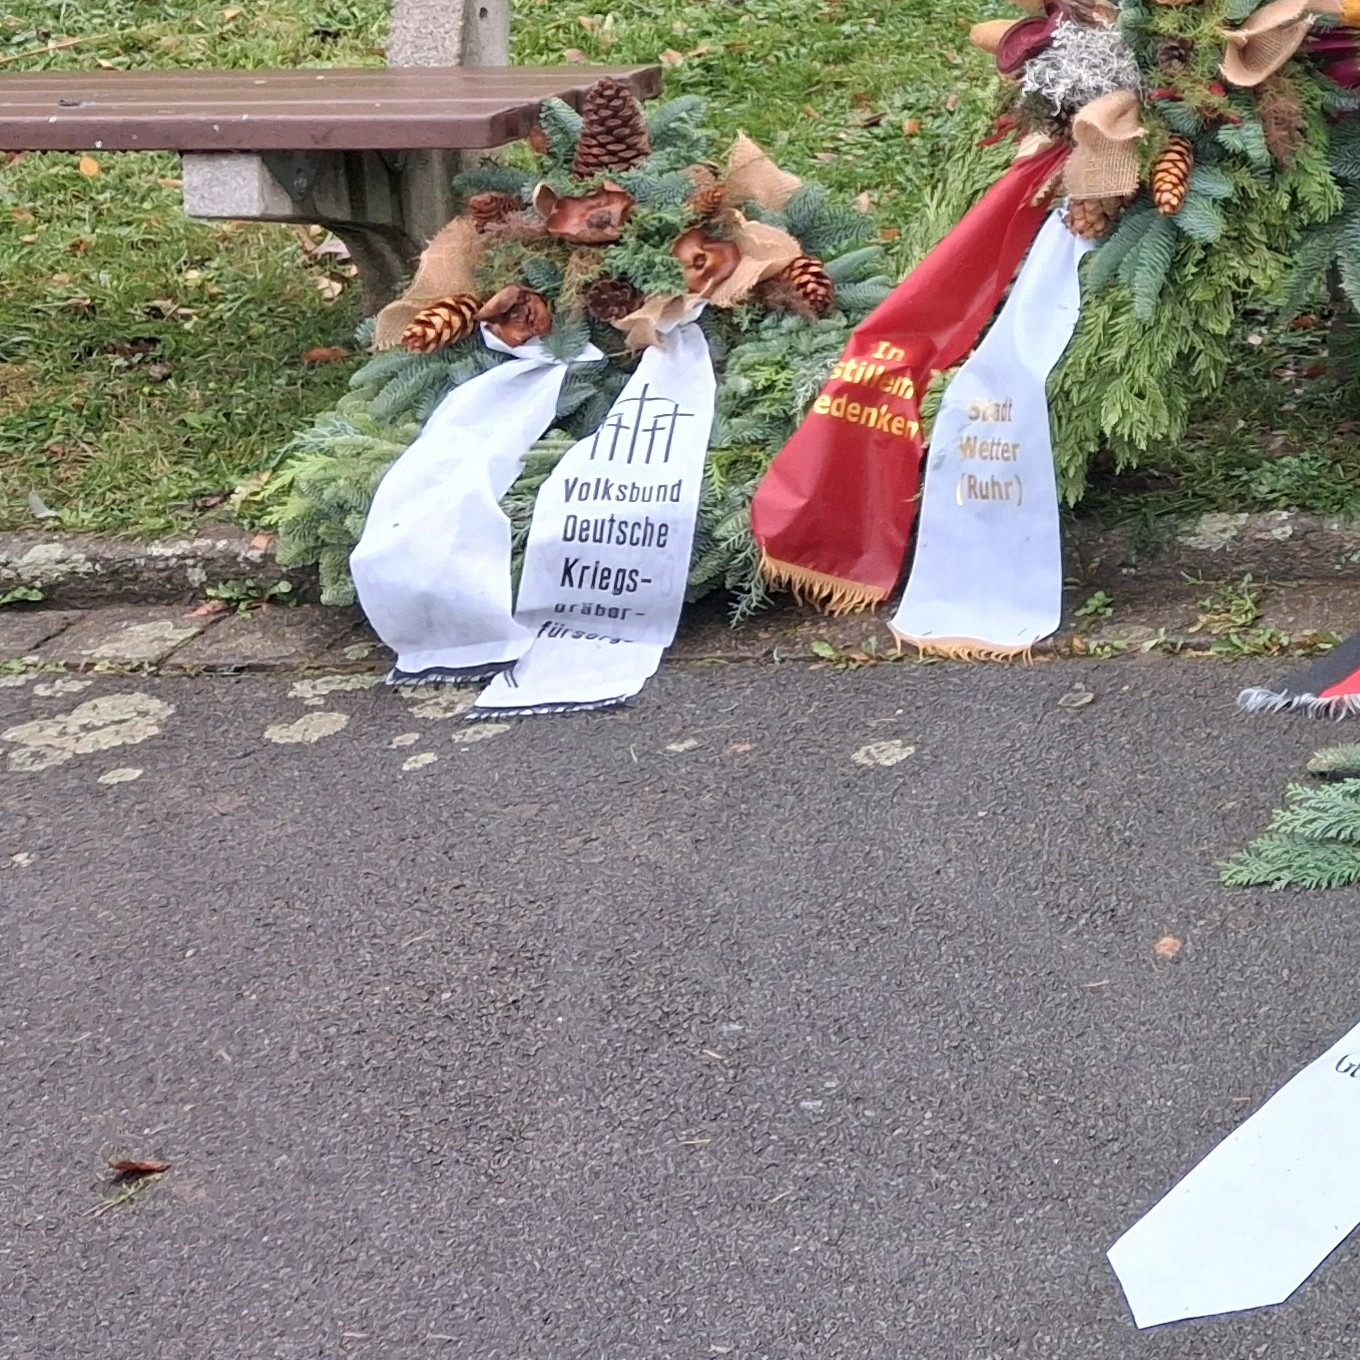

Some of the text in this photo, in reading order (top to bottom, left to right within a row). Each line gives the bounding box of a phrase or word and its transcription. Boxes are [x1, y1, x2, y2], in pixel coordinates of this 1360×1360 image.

[872, 340, 905, 362] In
[813, 393, 920, 441] edenken
[968, 397, 1013, 422] Stadt
[958, 436, 1020, 462] Wetter
[563, 476, 683, 503] Volksbund
[956, 472, 1023, 507] (Ruhr)
[561, 513, 669, 548] Deutsche
[559, 557, 652, 596] Kriegs-
